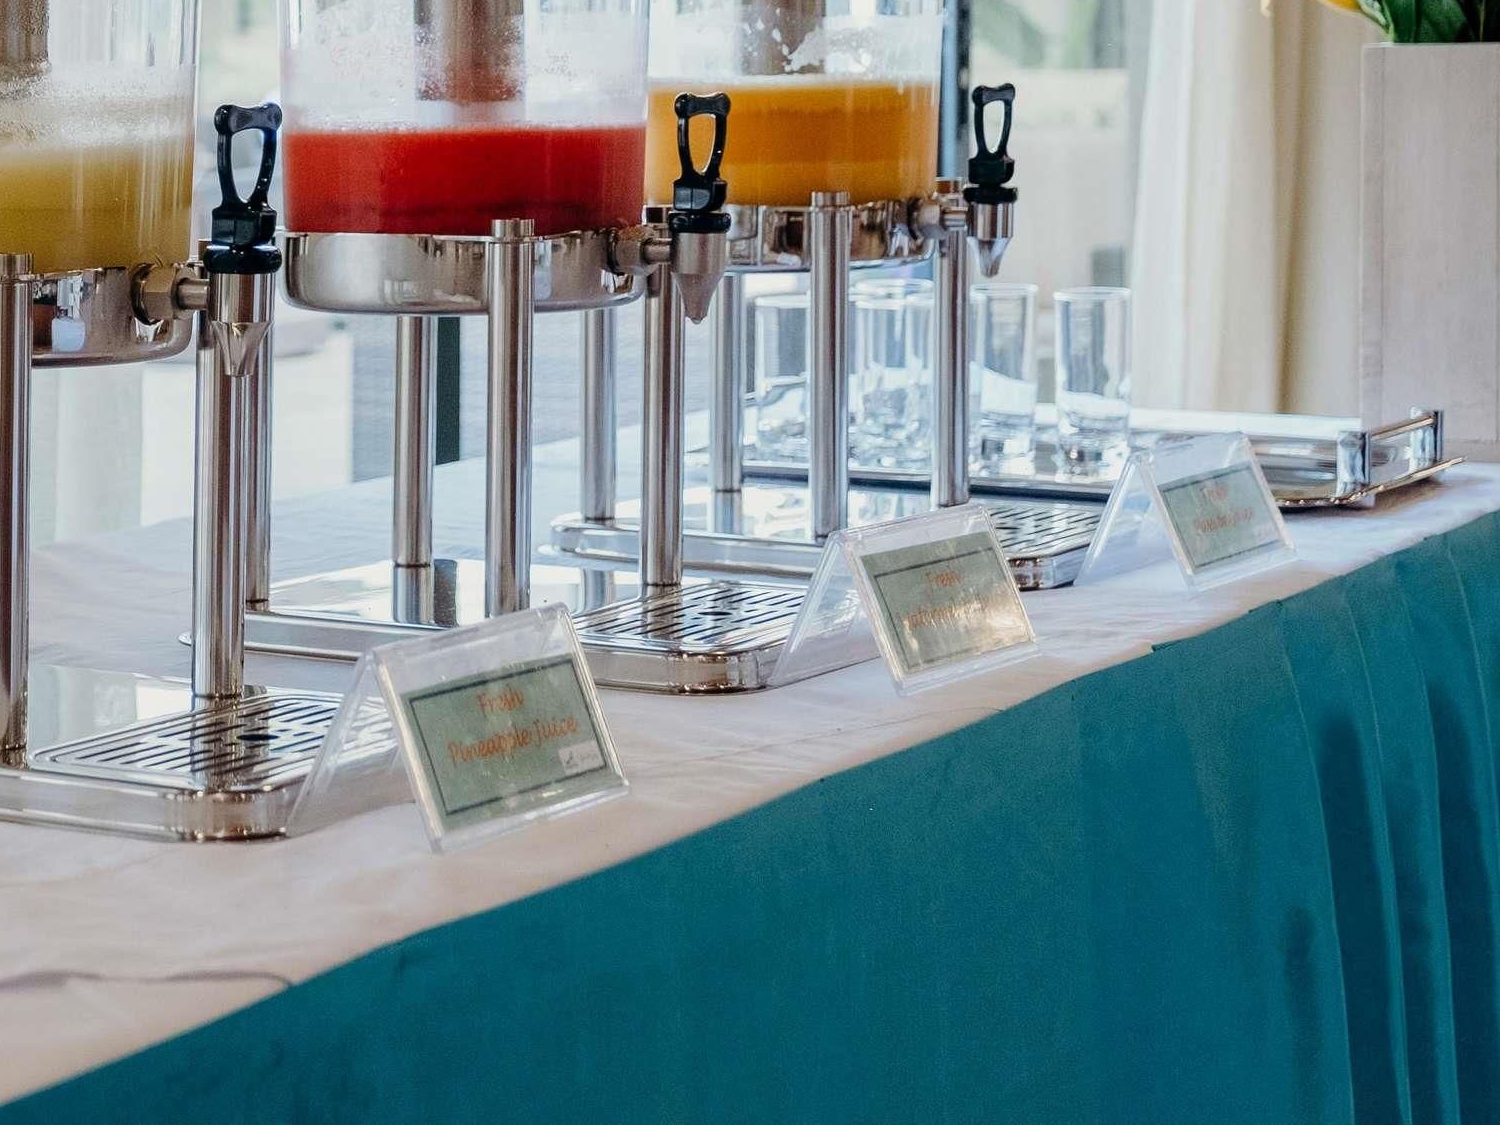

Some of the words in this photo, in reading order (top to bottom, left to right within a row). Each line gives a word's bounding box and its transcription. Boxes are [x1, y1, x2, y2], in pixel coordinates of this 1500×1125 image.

[477, 685, 525, 716] Fresh
[447, 723, 532, 766] Pineapple
[532, 715, 577, 747] Juice
